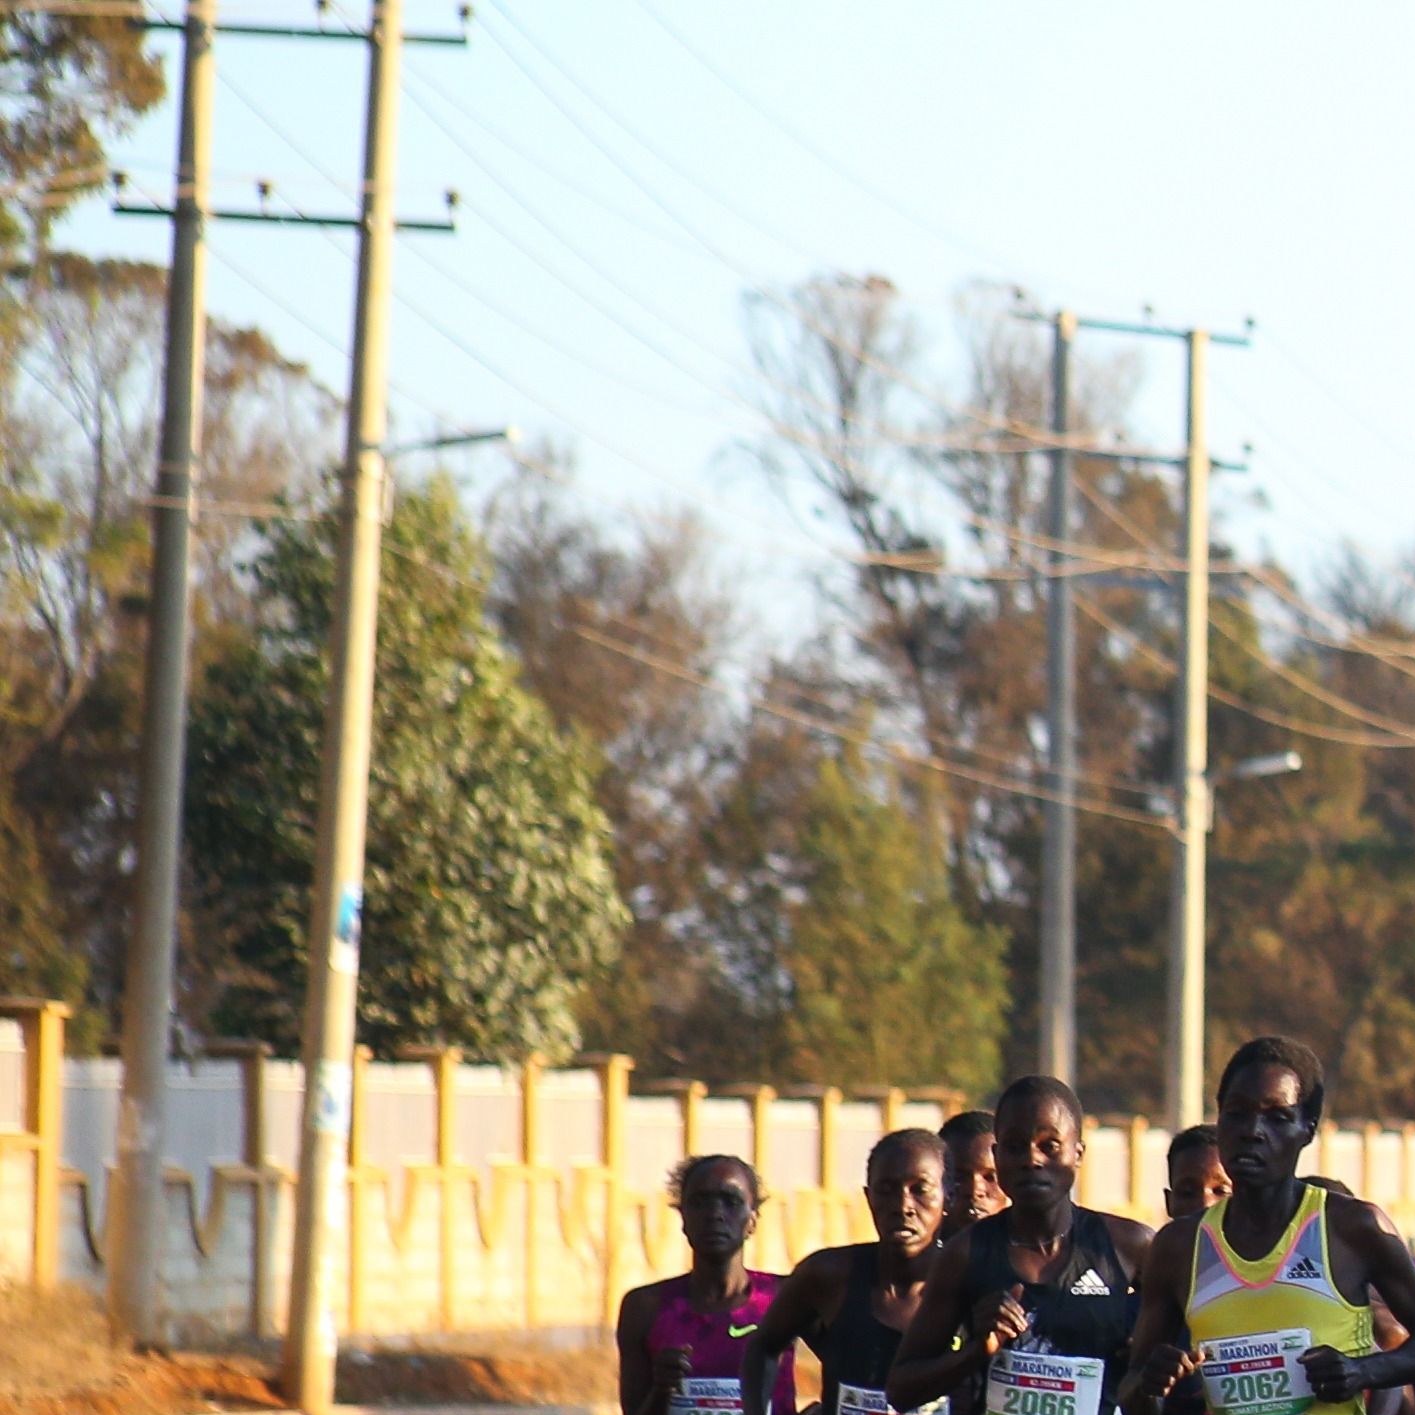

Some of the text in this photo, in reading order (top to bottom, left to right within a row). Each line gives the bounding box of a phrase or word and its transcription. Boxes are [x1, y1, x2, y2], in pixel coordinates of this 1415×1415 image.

[1071, 1284, 1110, 1296] adidas
[1220, 1342, 1279, 1361] MARATHON
[1012, 1360, 1073, 1379] MARATHON
[1221, 1370, 1292, 1403] 2062
